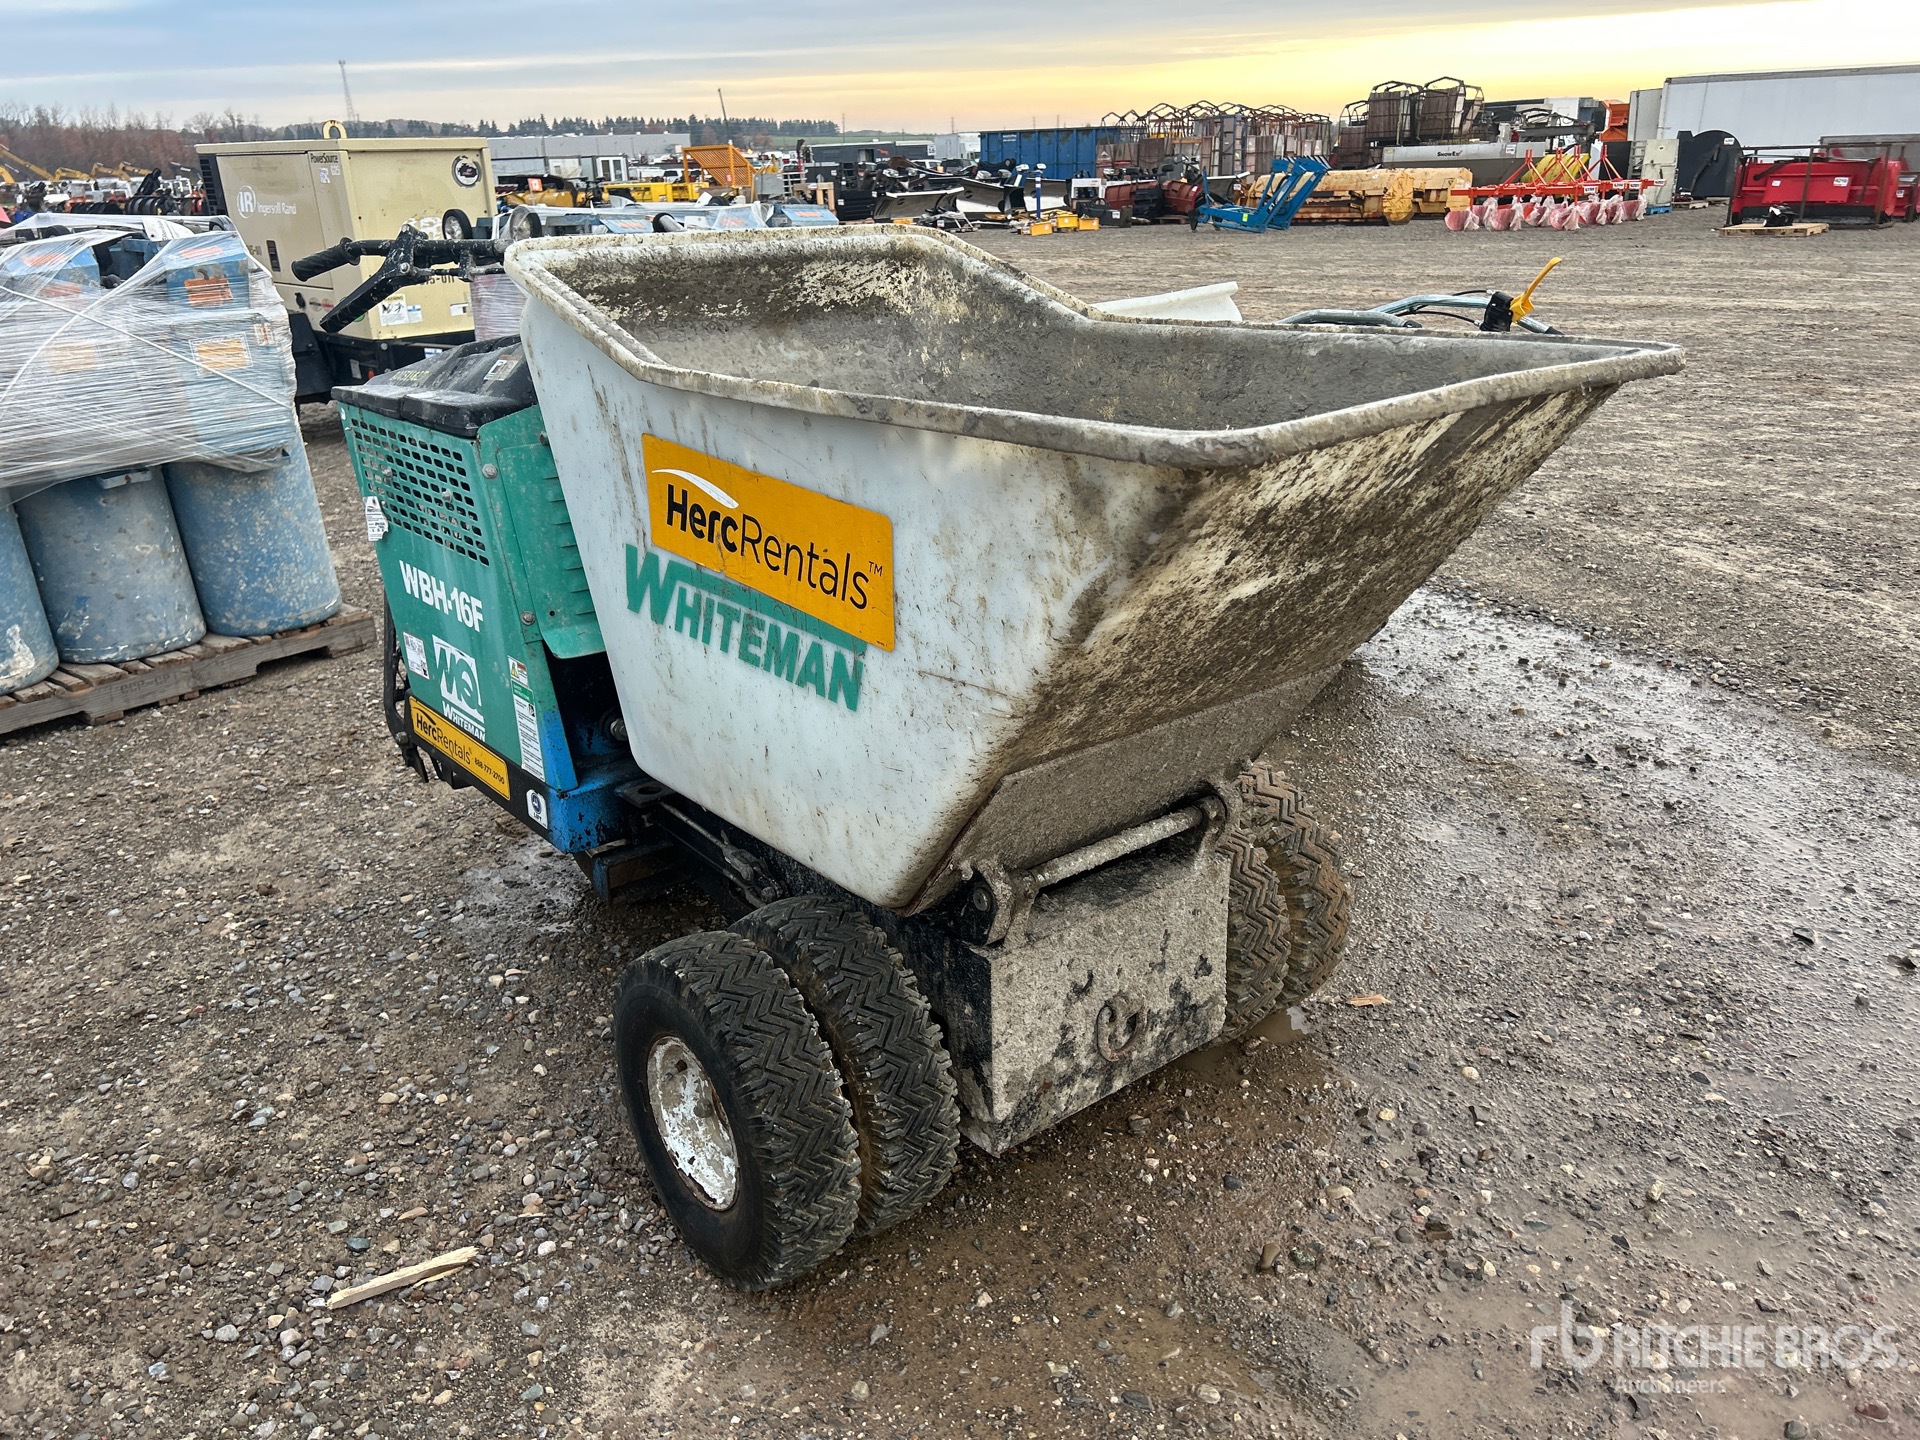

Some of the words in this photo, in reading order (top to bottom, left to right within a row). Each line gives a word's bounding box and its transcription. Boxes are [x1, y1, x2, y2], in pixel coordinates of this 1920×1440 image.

[310, 153, 339, 164] PowerSource
[399, 560, 484, 633] WBH-16F
[625, 543, 867, 712] WHITEMAN
[416, 712, 471, 765] HercRentals
[442, 700, 485, 742] WHITEMAN
